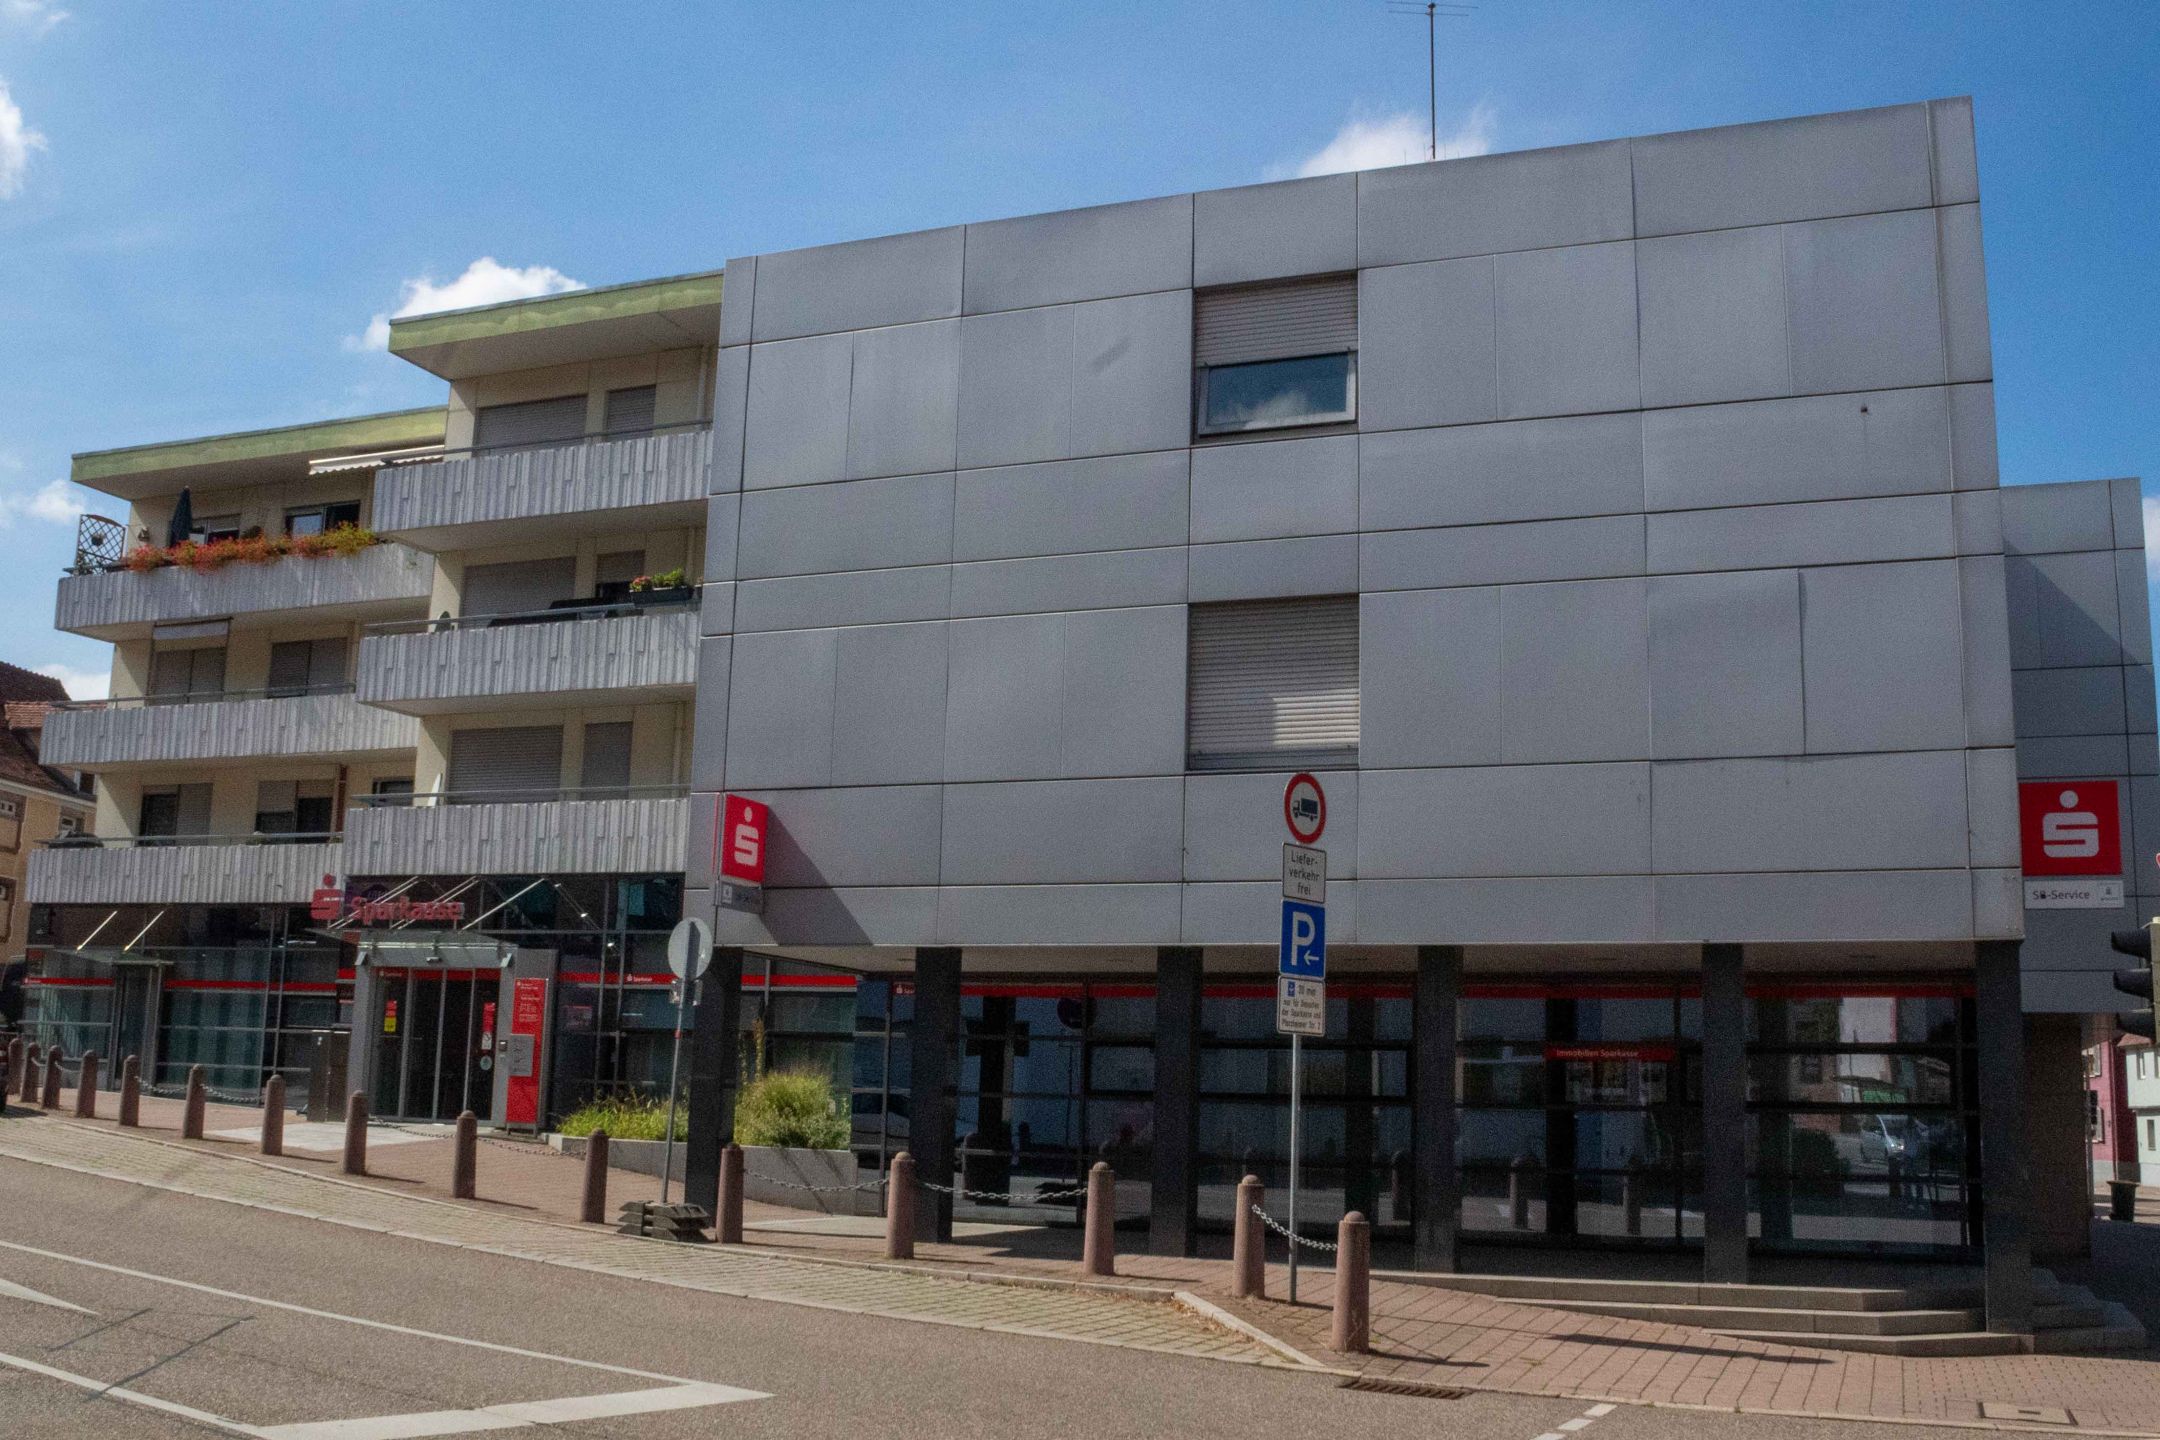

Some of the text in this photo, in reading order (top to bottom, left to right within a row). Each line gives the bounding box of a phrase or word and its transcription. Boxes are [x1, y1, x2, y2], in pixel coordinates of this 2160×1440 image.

[1291, 850, 1318, 866] Liefer-
[1289, 868, 1320, 882] verkehr
[1297, 882, 1311, 896] frei
[2032, 889, 2090, 901] SB-Service
[352, 896, 465, 926] Sparkasse
[1291, 911, 1316, 966] P
[1556, 1048, 1640, 1059] Immobilien Sparkasse
